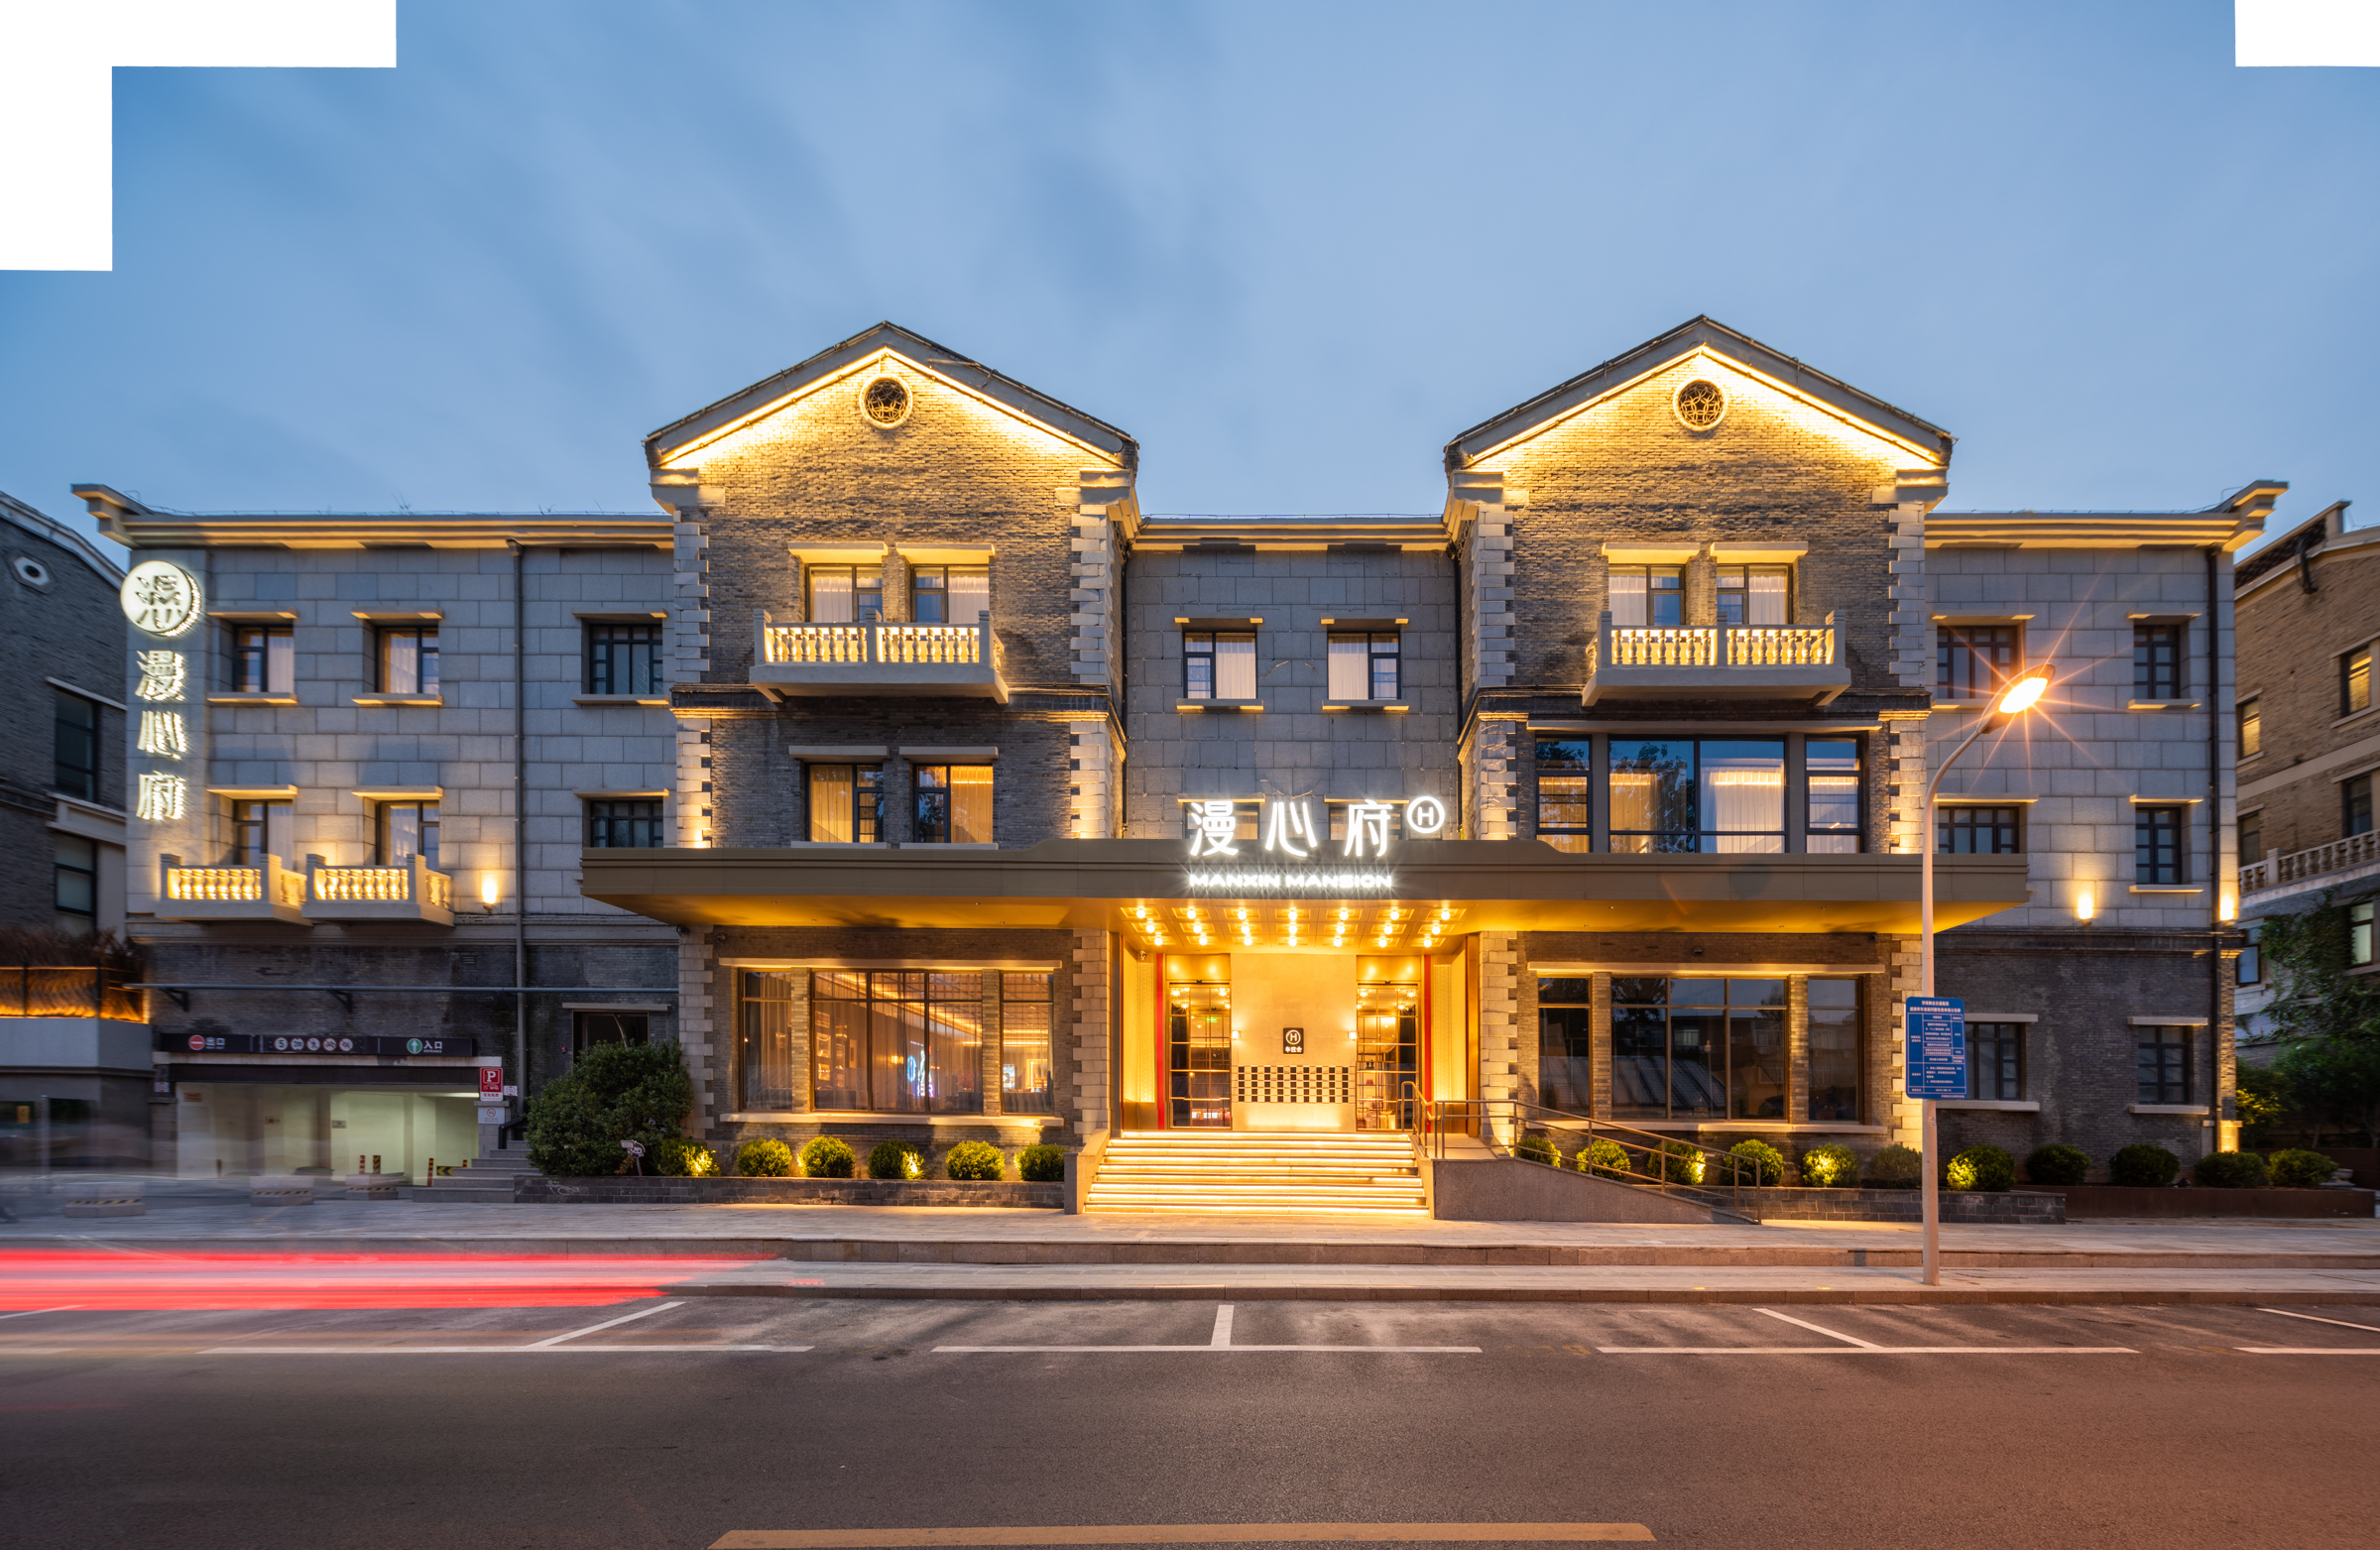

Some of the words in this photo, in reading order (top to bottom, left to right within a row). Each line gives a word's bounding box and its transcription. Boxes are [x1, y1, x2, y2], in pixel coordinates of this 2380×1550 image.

[135, 650, 186, 821] 漫心府
[1190, 799, 1393, 858] 漫心府
[1189, 874, 1280, 888] MANXIN
[1285, 874, 1392, 889] MANSION
[423, 1040, 443, 1049] 入口
[486, 1071, 496, 1082] P
